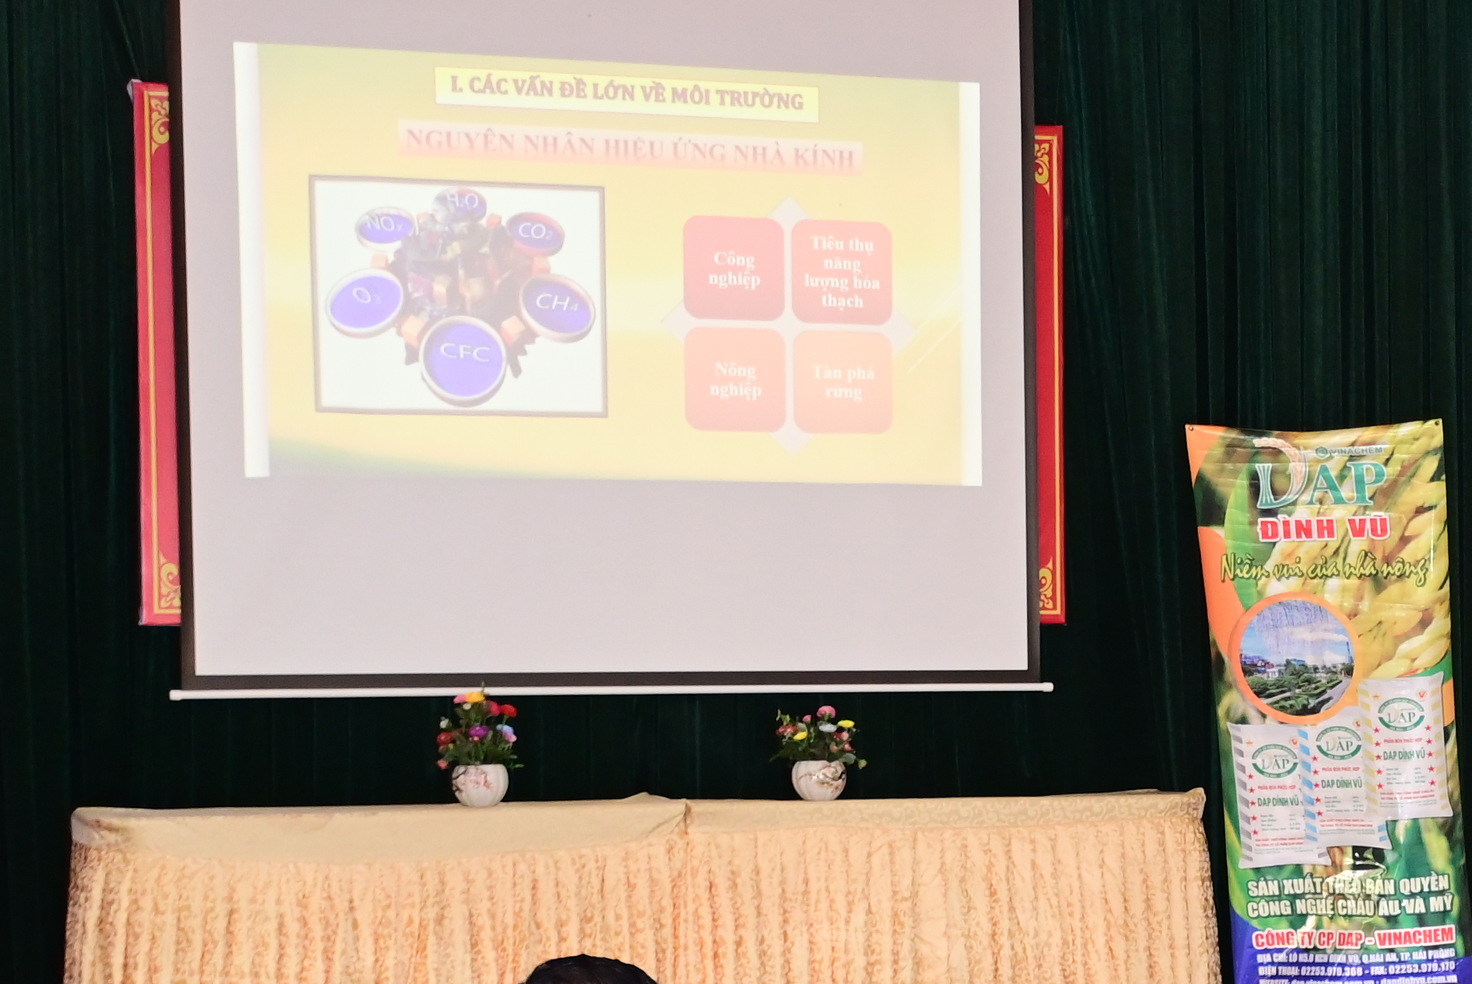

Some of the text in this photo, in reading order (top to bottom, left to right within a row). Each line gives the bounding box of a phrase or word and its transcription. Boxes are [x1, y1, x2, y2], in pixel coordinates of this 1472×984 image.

[469, 73, 508, 96] CÁC
[513, 74, 554, 98] VẤN
[559, 76, 588, 100] ĐỀ
[593, 79, 635, 102] LỚN
[640, 81, 666, 104] VỀ
[671, 84, 711, 106] MÔI
[715, 86, 804, 111] TRƯỜNG
[405, 126, 855, 169] NGUYÊN NHÂN HIỆU ỨNG NHÀ KÍNH
[810, 236, 874, 256] Tiêu thụ
[714, 251, 755, 269] Công
[709, 271, 761, 290] nghiệp
[804, 273, 880, 292] lượng hóa
[822, 294, 864, 311] thạch
[440, 343, 490, 362] CFC
[715, 362, 756, 381] Nông
[710, 382, 762, 401] nghiệp
[1253, 437, 1387, 510] DAP
[1258, 512, 1391, 542] ĐÌNH VŨ
[1220, 550, 1430, 587] Niềm vui của nhà nông
[1247, 872, 1449, 896] SẢN XUẤT THEO BẢN QUYỀN
[1247, 897, 1292, 917] CÔNG
[1296, 896, 1334, 918] NGHỆ
[1337, 896, 1375, 916] CHÂU
[1403, 896, 1426, 914] VÀ
[1429, 892, 1454, 912] MỸ
[1255, 926, 1455, 948] CÔNG TY CP DAP VINACHEM
